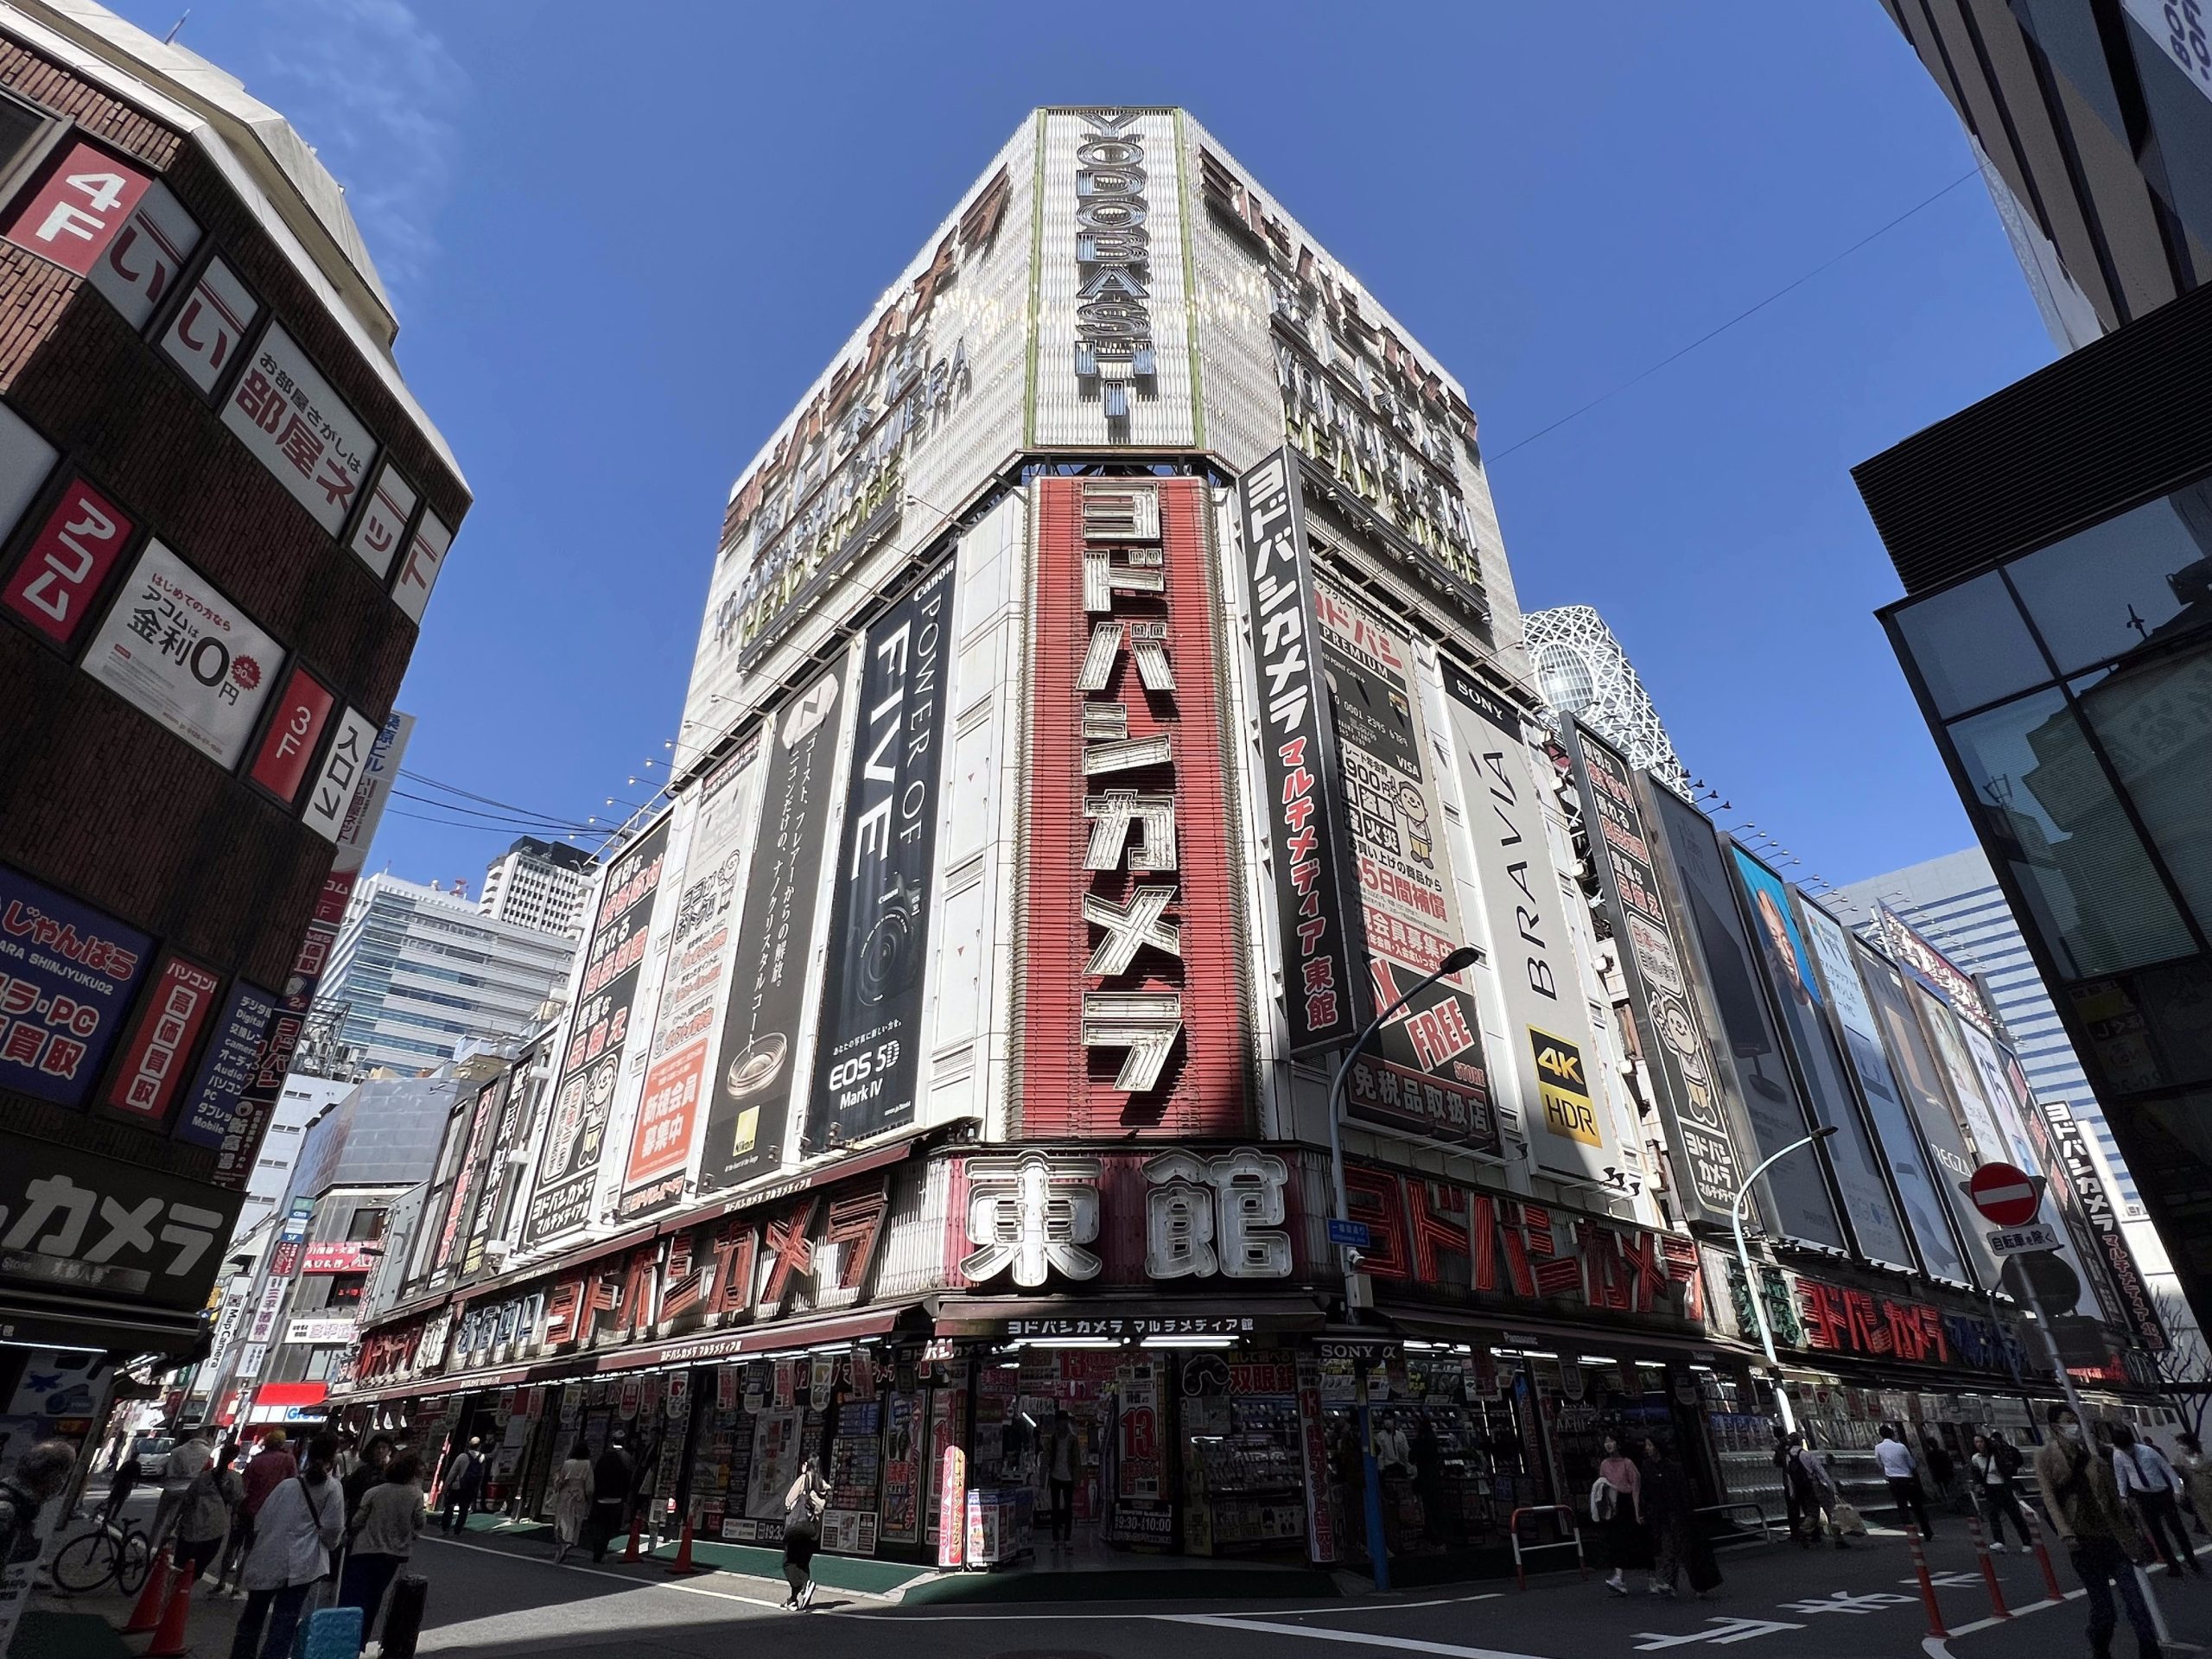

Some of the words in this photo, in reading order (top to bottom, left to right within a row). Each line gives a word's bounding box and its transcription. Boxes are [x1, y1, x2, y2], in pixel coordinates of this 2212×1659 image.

[35, 173, 127, 242] 4F
[1074, 111, 1154, 417] YODOBASHI
[259, 351, 362, 474] お部屋さがしは
[22, 498, 117, 622] アコム
[914, 559, 955, 602] Canon
[141, 585, 200, 639] アコムは
[151, 572, 232, 632] はじめての方なら
[126, 607, 240, 706] 金利0円
[1322, 626, 1389, 679] PREMIUM
[907, 593, 942, 768] POWER
[1456, 678, 1503, 721] SONY
[276, 705, 312, 759] 3F
[327, 725, 359, 790] 入口
[1248, 457, 1309, 734] ヨドバシカメラ
[1279, 735, 1340, 1032] マルチメディア東館
[1076, 481, 1184, 1090] ヨドバシカメラ
[1396, 754, 1420, 778] VISA
[899, 779, 926, 844] OF
[1483, 753, 1558, 1001] BRAVIA
[2, 899, 138, 981] じゃんばら
[236, 1009, 265, 1029] Digital
[568, 1006, 628, 1071] 品揃え
[1404, 995, 1475, 1074] FREE
[0, 1016, 87, 1080] 買取
[126, 985, 197, 1110] 高価買取
[829, 1051, 873, 1092] EOS
[875, 1039, 900, 1073] 5D
[1453, 1061, 1486, 1087] STORE
[1537, 1046, 1584, 1084] 4K
[204, 1089, 217, 1102] PC
[643, 1073, 697, 1126] 新規会員
[840, 1084, 868, 1110] Mark
[868, 1078, 884, 1097] IV
[1352, 1062, 1490, 1133] 免税品取扱店
[1547, 1093, 1597, 1138] HDR
[192, 1116, 225, 1135] Mobile
[641, 1114, 684, 1160] 募集中
[734, 1140, 754, 1153] Nikon
[1685, 1131, 1732, 1165] ヨドバシ
[1698, 1160, 1732, 1190] カメラ
[1931, 1143, 1972, 1178] REGZA
[2044, 1103, 2113, 1233] ヨドバシカメラ
[531, 1174, 596, 1220] ヨドバシカメラ
[724, 1189, 765, 1213] ヨドバシカメラ
[960, 1147, 1293, 1287] 東館
[546, 1174, 889, 1344] ヨドバシカメラ
[1344, 1166, 1702, 1321] ヨドバシカメラ
[1992, 1230, 2056, 1252] 自転車を除く
[1007, 1319, 1123, 1335] ヨドバシカメラ
[1796, 1277, 1947, 1363] ヨドバシカメラ
[660, 1345, 698, 1363] ヨドバシカメラ
[1320, 1344, 1375, 1359] SONY
